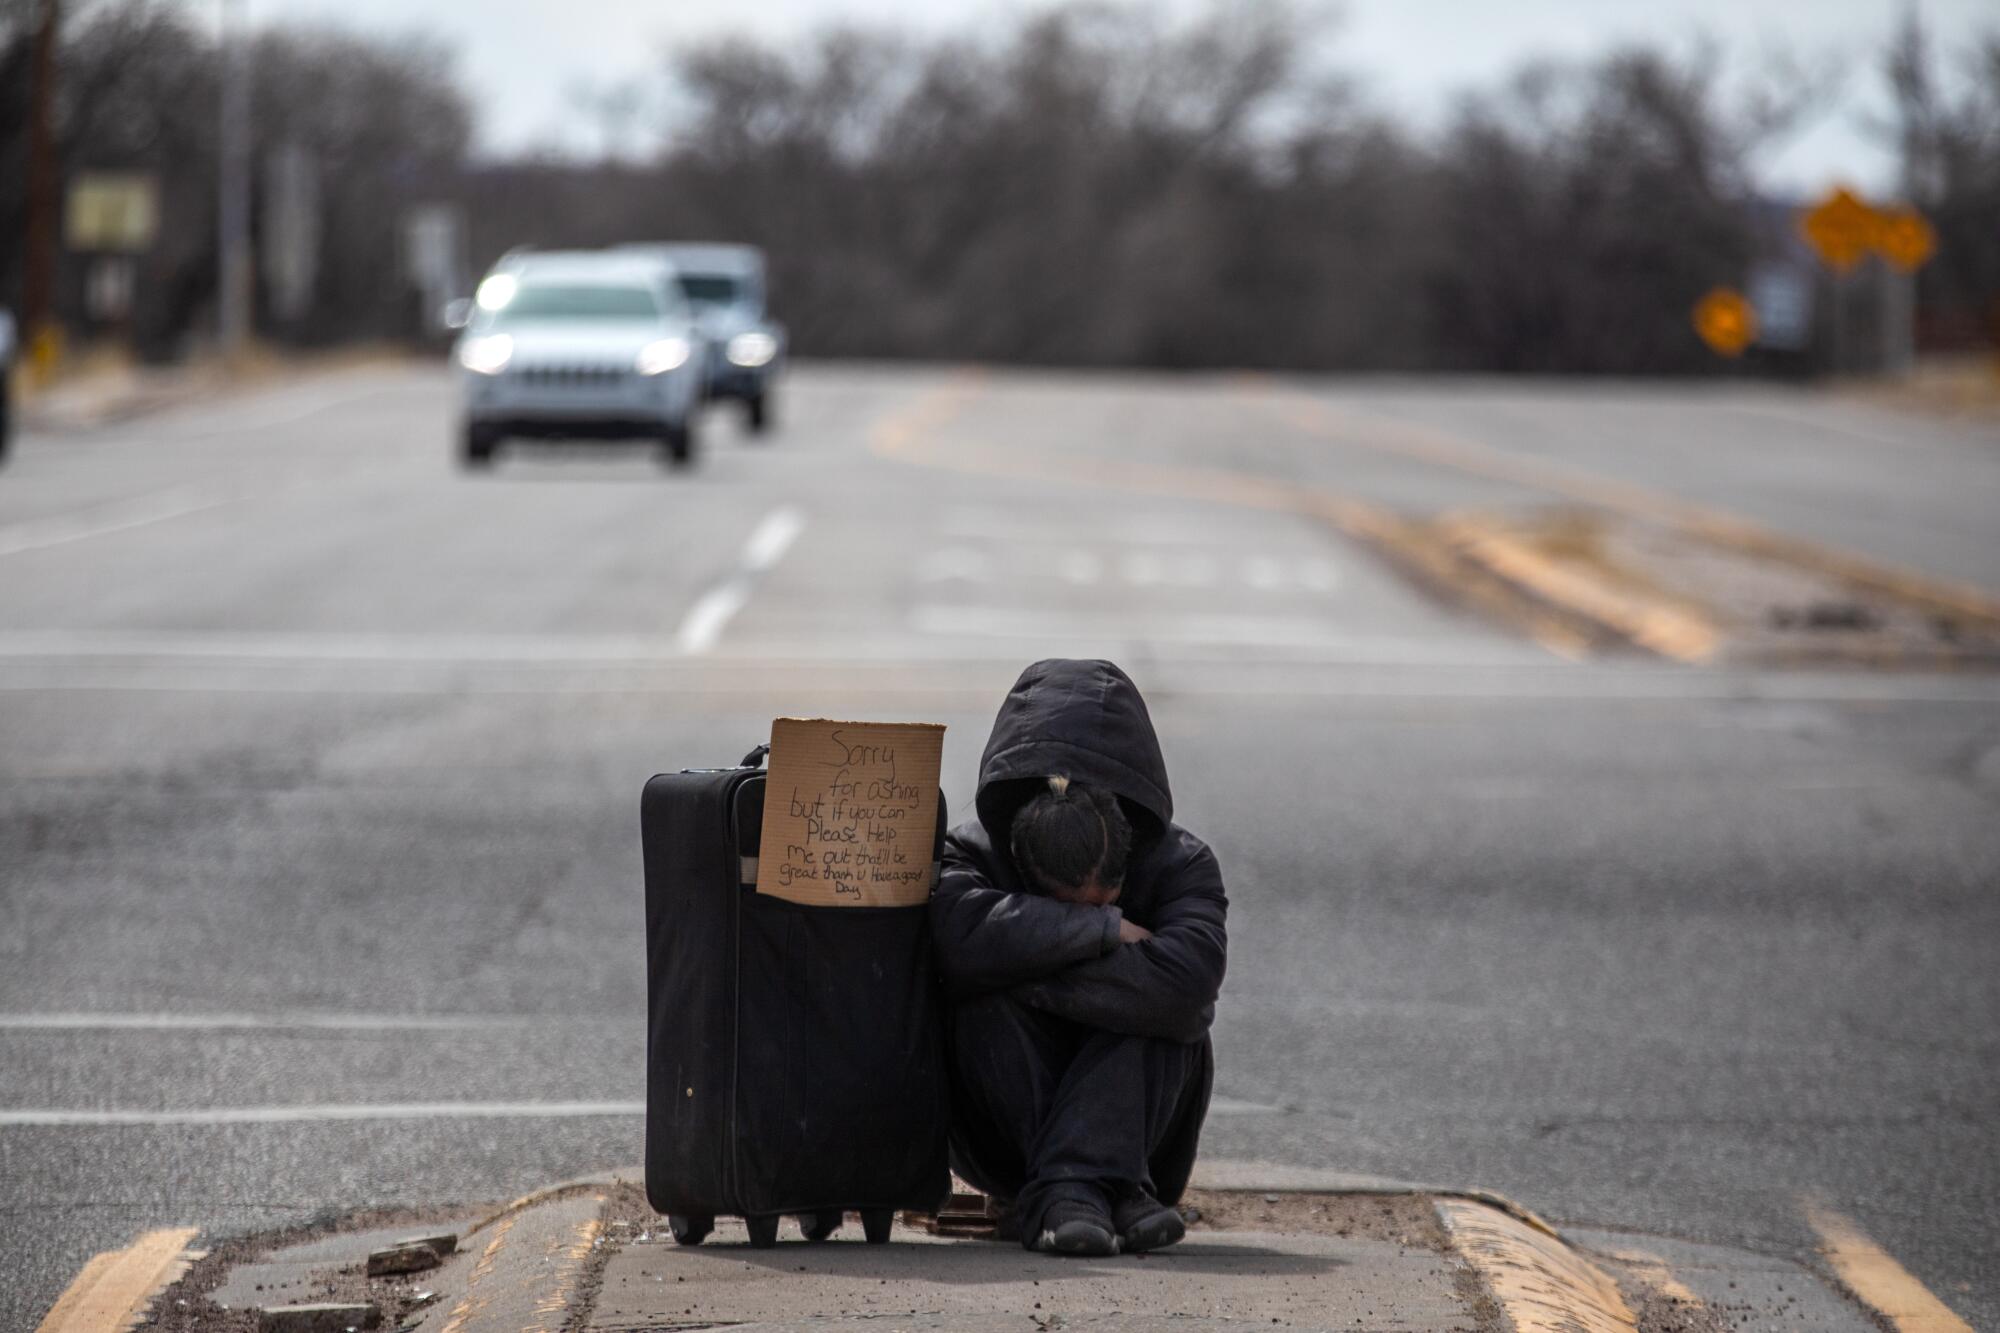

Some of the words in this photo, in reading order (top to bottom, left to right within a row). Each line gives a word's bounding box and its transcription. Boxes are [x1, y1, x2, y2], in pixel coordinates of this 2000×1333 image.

[817, 729, 896, 783] Sorry
[829, 768, 862, 798] for
[790, 784, 825, 819] but
[833, 798, 848, 821] if
[849, 807, 875, 829] you
[807, 818, 859, 846] Please
[867, 821, 897, 845] Help
[823, 847, 852, 865] out
[894, 845, 908, 865] be
[892, 871, 901, 881] a
[834, 881, 862, 900] Day
